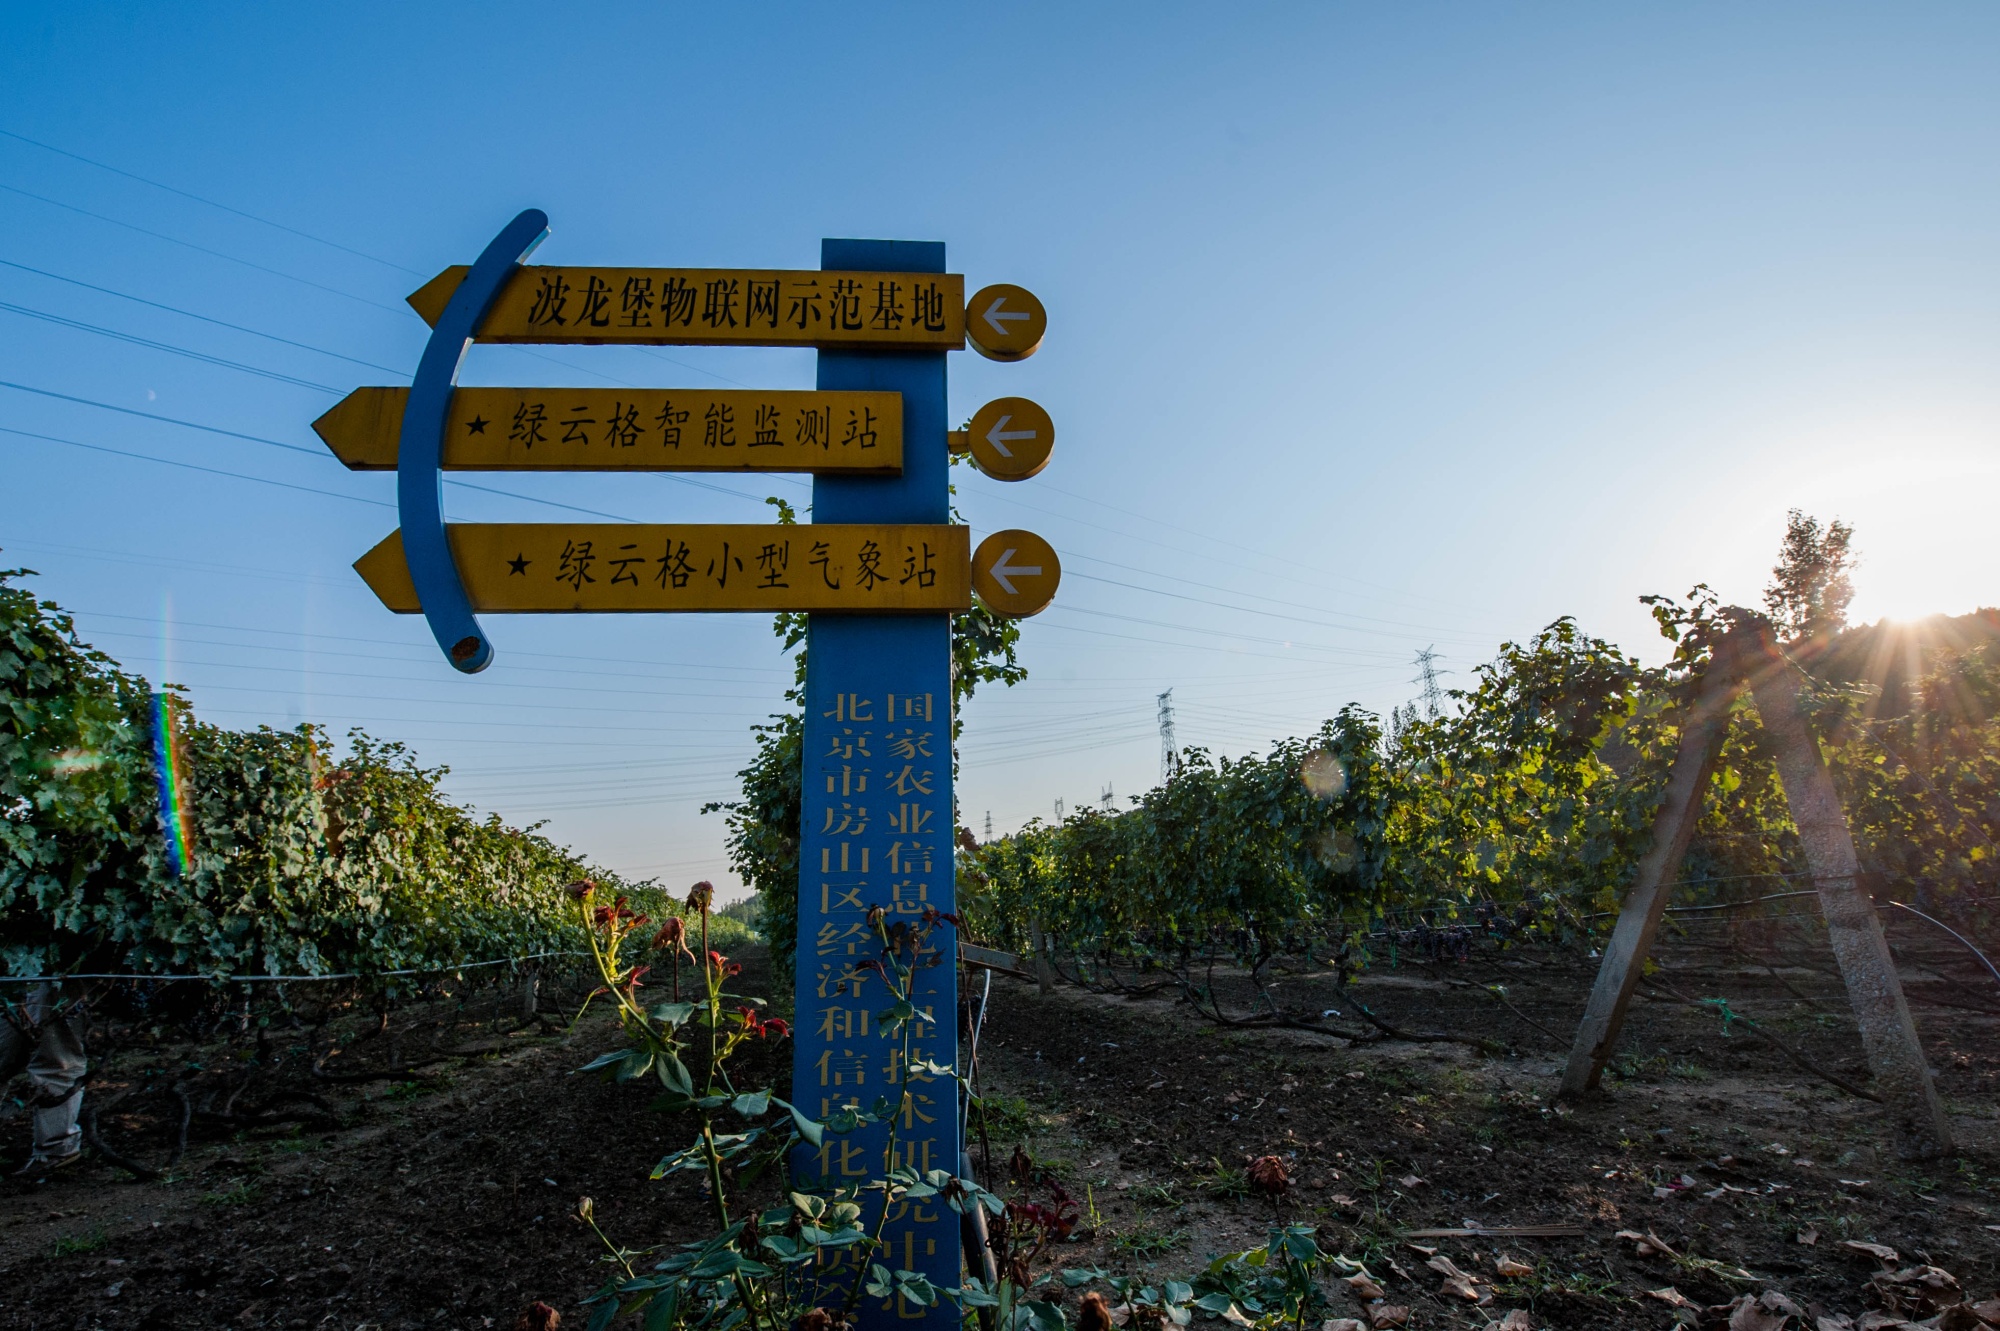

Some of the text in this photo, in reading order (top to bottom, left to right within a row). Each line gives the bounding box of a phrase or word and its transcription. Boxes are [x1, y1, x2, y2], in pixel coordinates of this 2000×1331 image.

[527, 274, 947, 333] 波龙堡物联网示范基地
[507, 401, 879, 451] 绿云格智能监测站
[555, 539, 938, 592] 绿云格小型气象站
